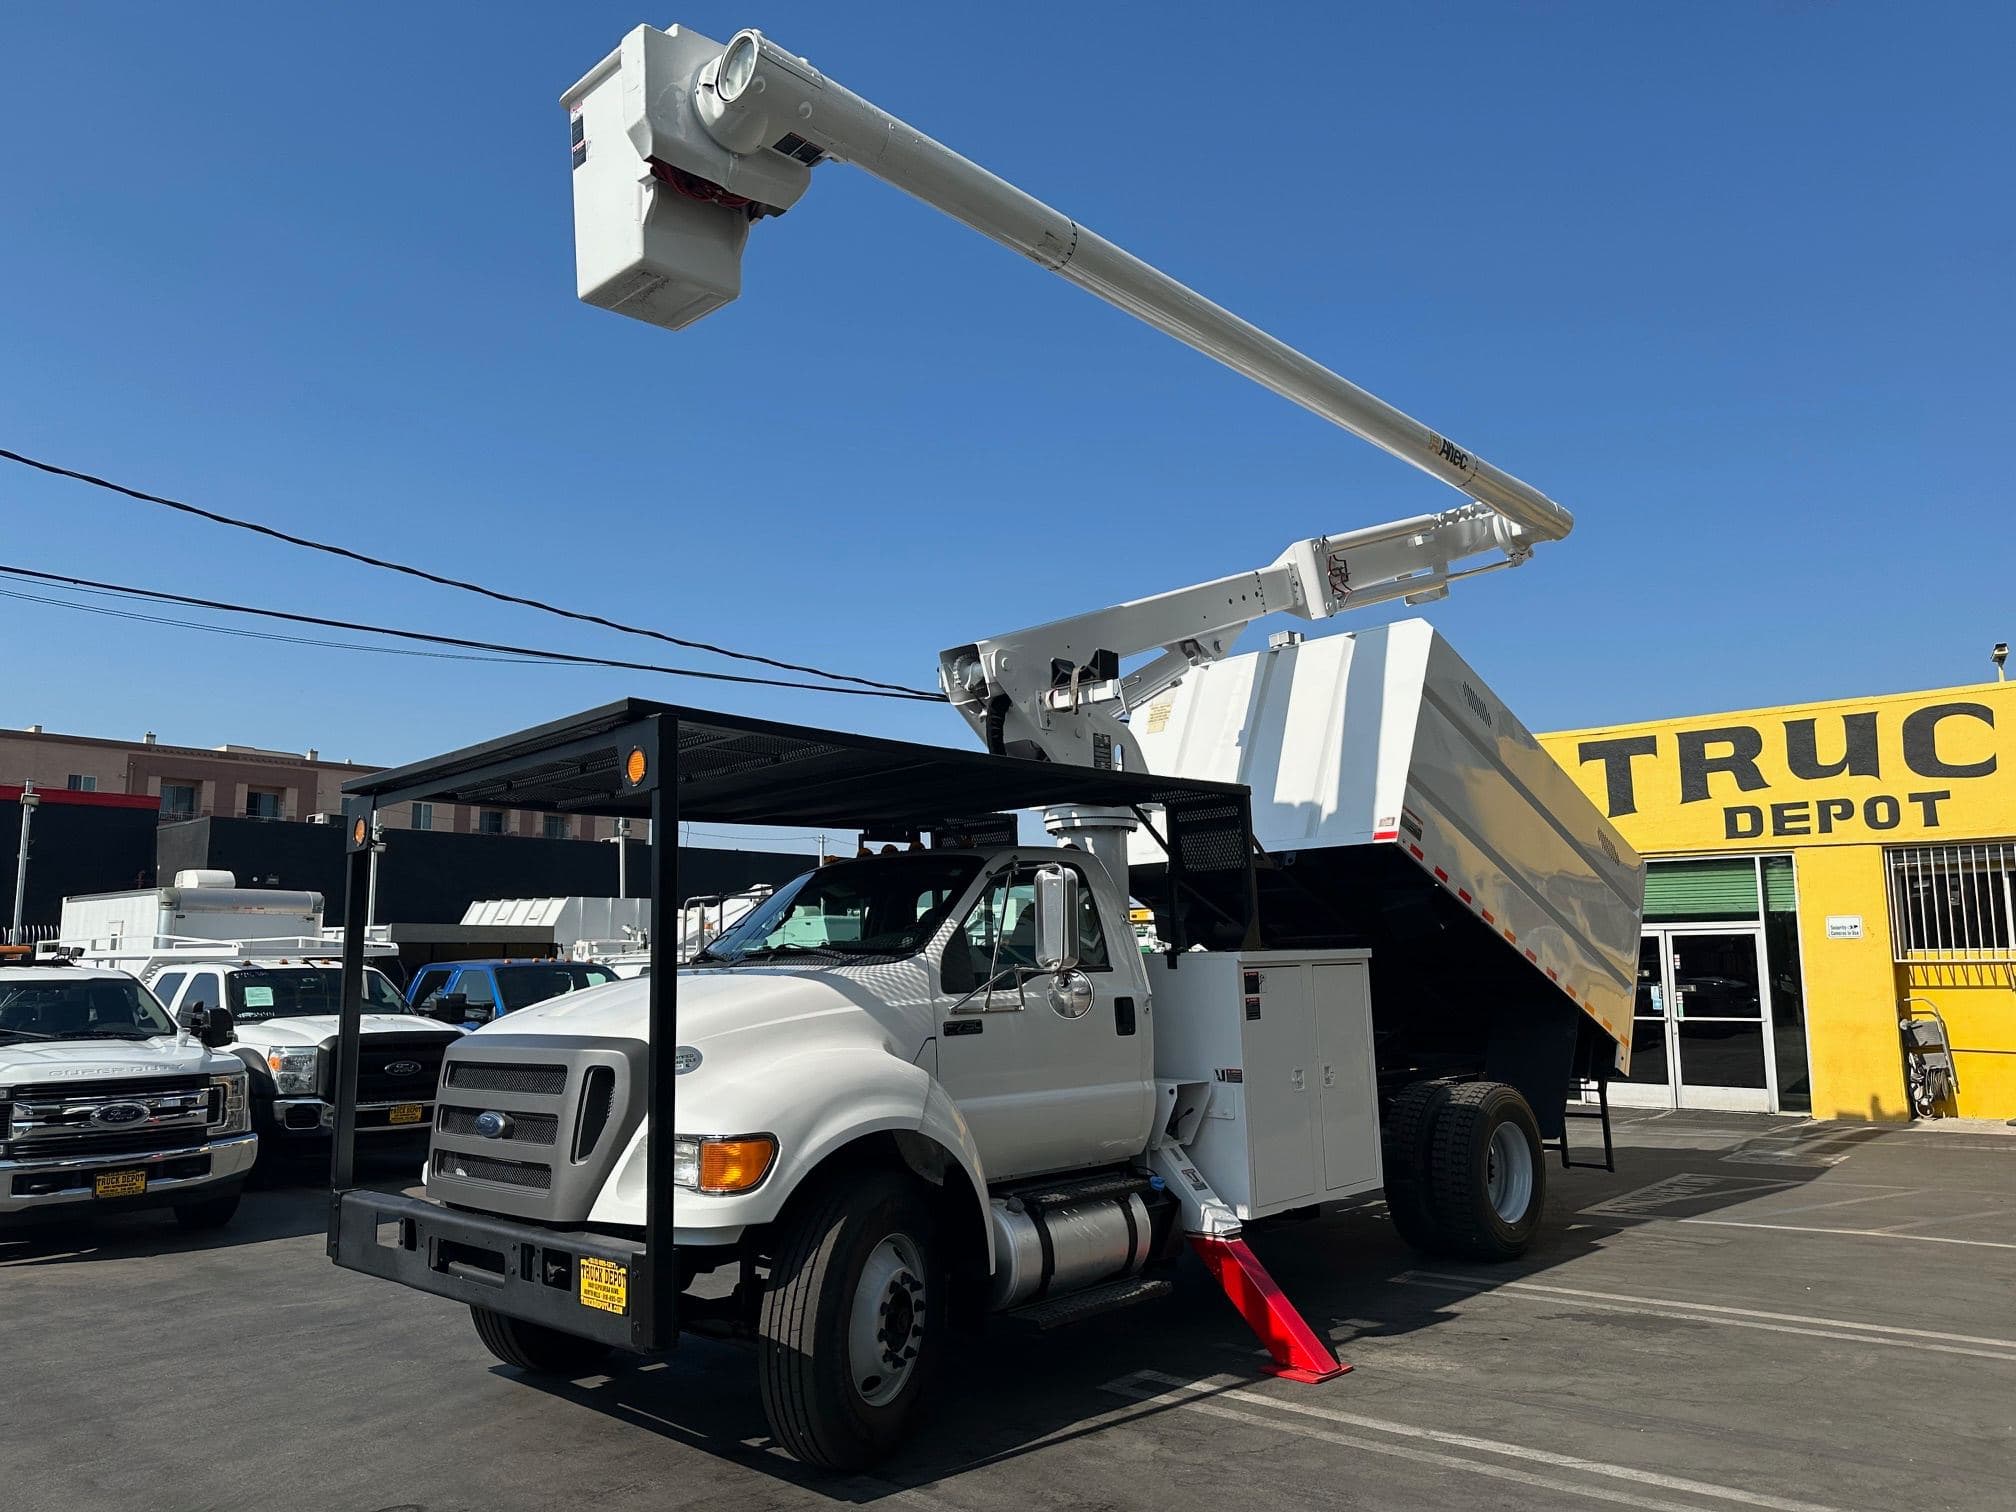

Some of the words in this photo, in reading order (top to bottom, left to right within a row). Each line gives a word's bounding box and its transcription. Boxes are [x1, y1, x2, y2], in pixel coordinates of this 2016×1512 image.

[1439, 438, 1468, 470] Altec
[1578, 702, 1997, 818] TRUC
[1723, 790, 1951, 839] DEPOT
[49, 1066, 126, 1077] SUPER
[130, 1063, 185, 1073] DUTY
[107, 1109, 136, 1121] Ford
[97, 1175, 120, 1187] TRUCK
[121, 1173, 145, 1184] DEPOT
[581, 1264, 603, 1283] TRUCK
[604, 1269, 627, 1289] DEPOT
